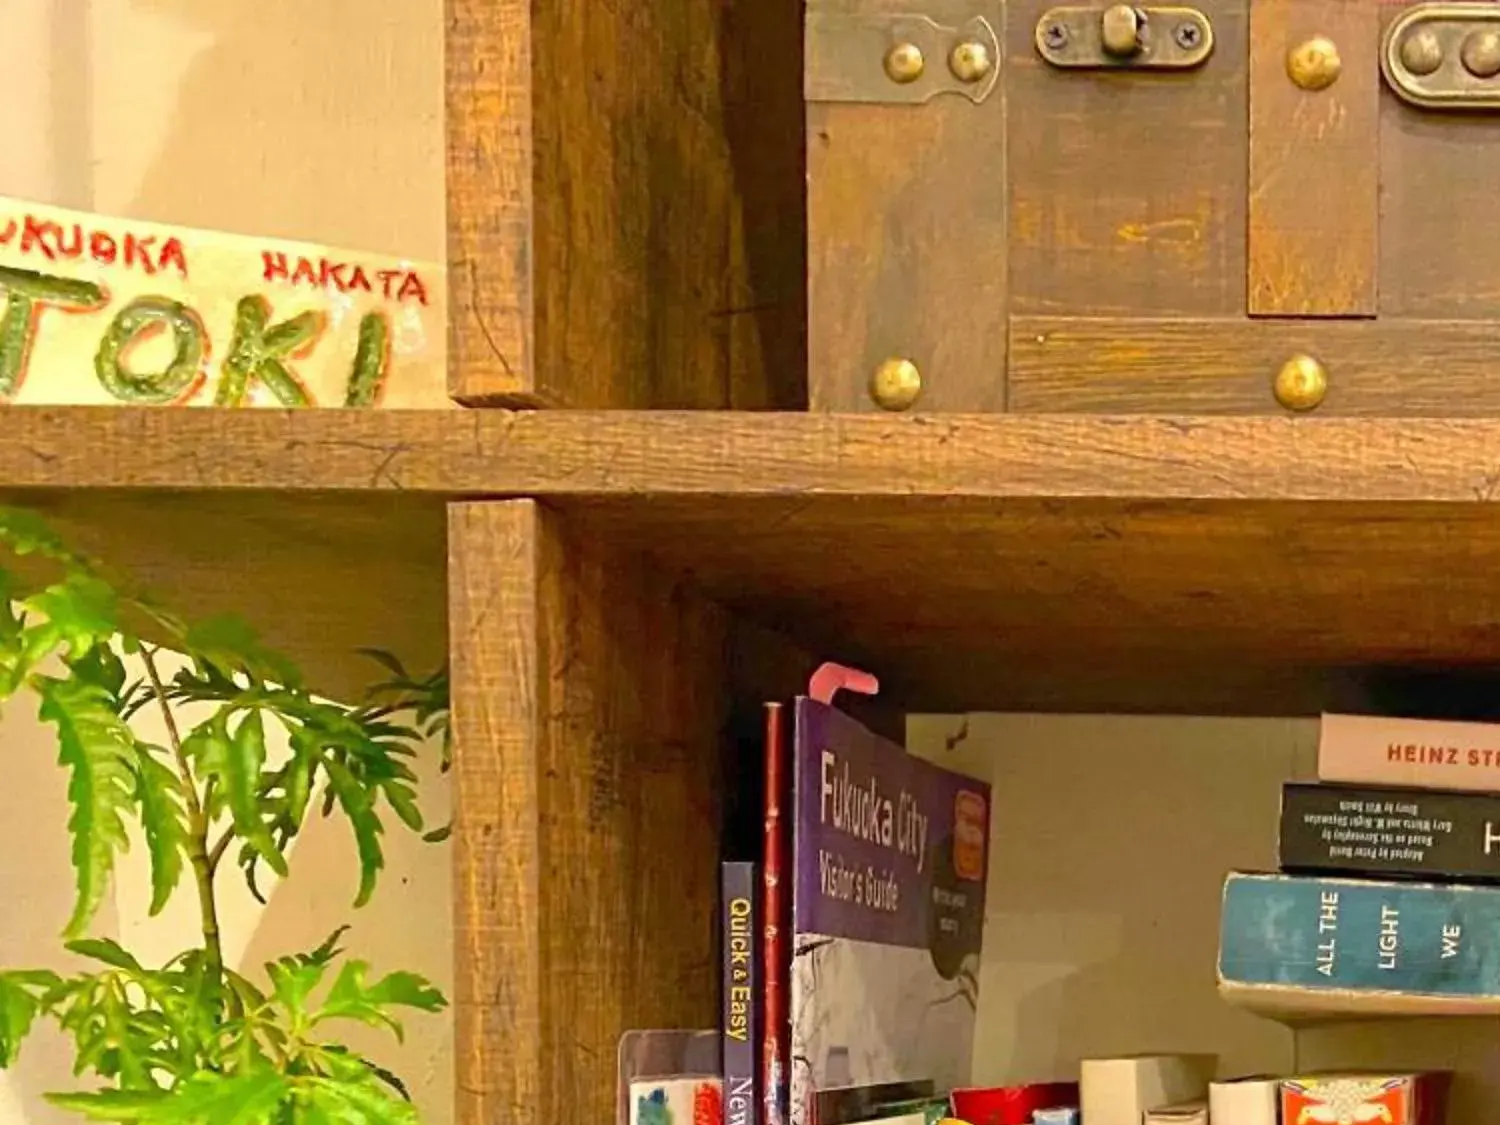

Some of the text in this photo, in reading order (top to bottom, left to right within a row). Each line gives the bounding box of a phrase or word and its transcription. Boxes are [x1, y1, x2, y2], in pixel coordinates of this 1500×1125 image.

[262, 250, 429, 305] HAKATA
[0, 264, 393, 407] TOKI
[1387, 743, 1459, 765] HEINZ
[820, 751, 928, 875] Fukuoka City
[818, 849, 862, 906] Visitor's
[864, 870, 898, 913] Guide
[730, 898, 751, 963] Quick
[1316, 890, 1339, 977] ALL THE
[1377, 904, 1400, 970] LIGHT
[1440, 923, 1462, 959] WE
[724, 984, 751, 1042] Easy
